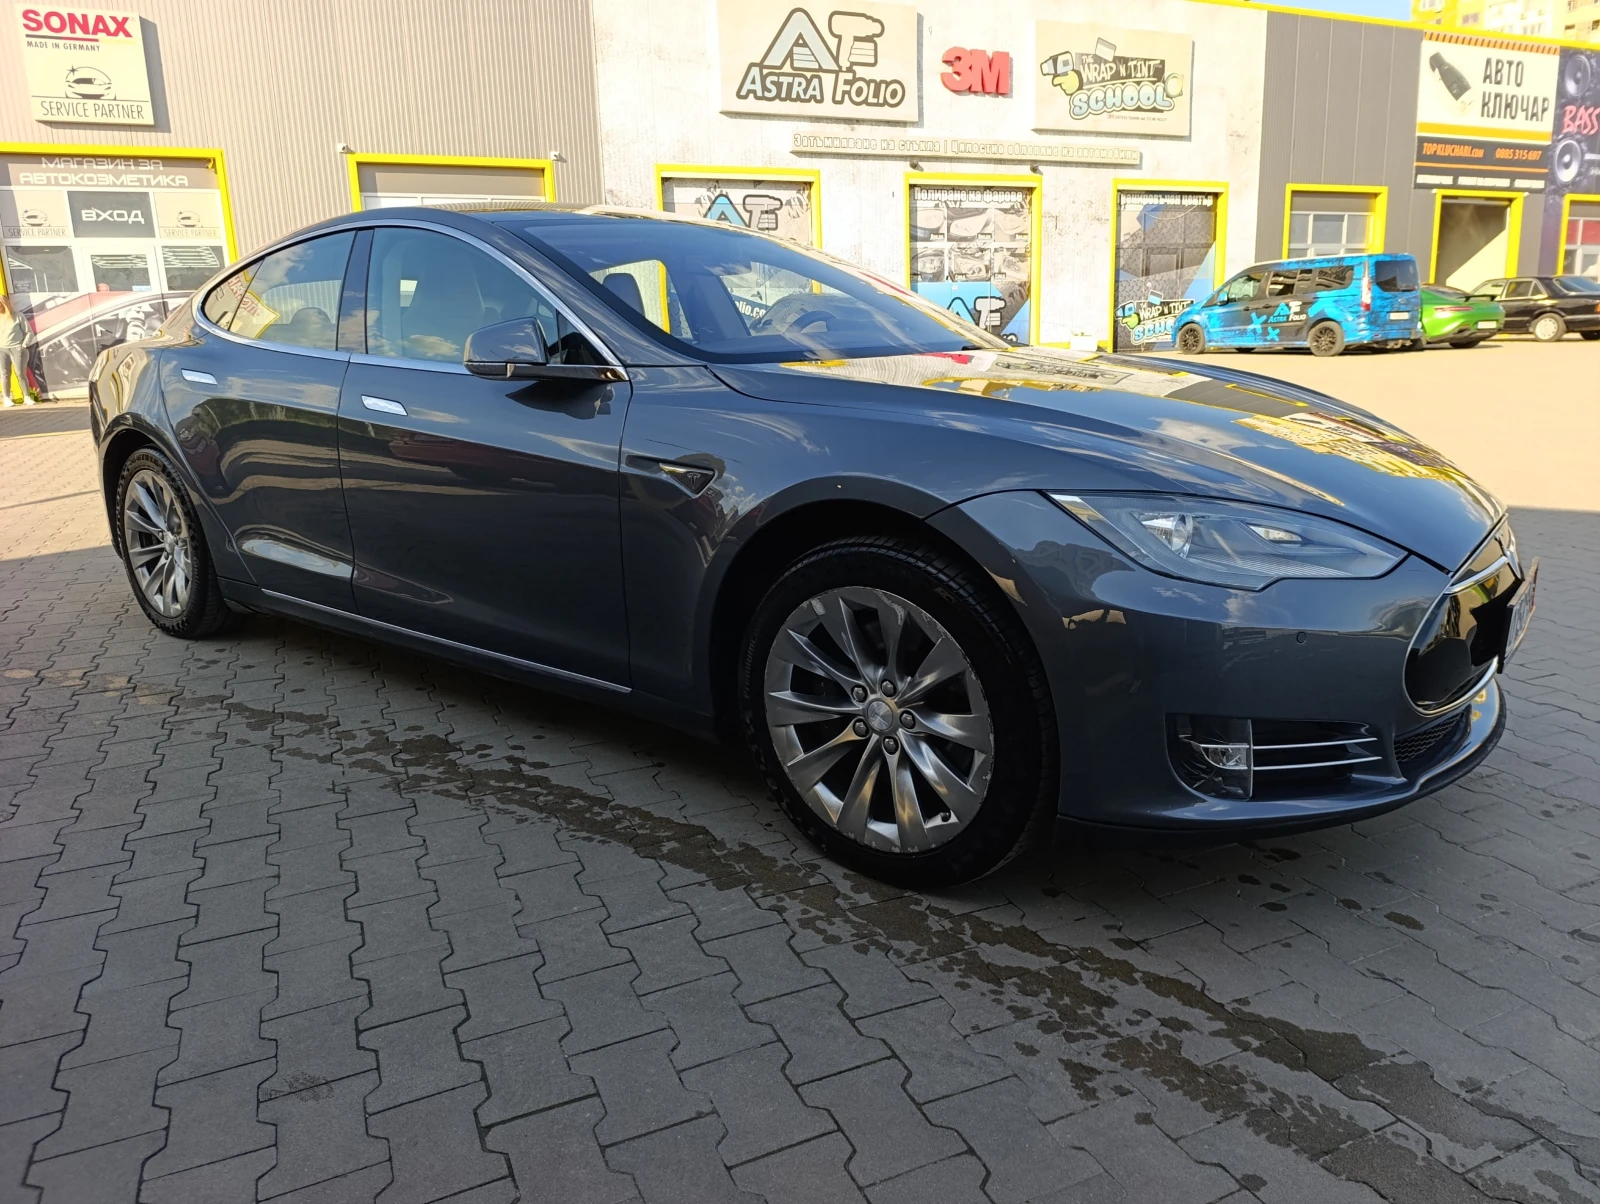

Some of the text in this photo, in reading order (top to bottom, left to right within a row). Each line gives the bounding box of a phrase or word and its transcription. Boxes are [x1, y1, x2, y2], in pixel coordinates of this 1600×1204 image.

[22, 9, 133, 38] SONAX
[26, 40, 100, 52] MADE IN GERMANY
[1082, 55, 1094, 63] THE
[940, 47, 1009, 95] 3M
[1080, 62, 1116, 83] WRAP
[1128, 60, 1160, 79] TINT
[1483, 57, 1524, 88] АВТО
[738, 64, 905, 107] ASTRA FOLIO
[1071, 83, 1173, 118] SCHOOL
[1481, 91, 1550, 122] КЛЮЧАР
[40, 101, 144, 120] SERVICE PARTNER
[794, 133, 877, 150] Затъмняване
[881, 138, 896, 151] на
[899, 139, 941, 153] стъкла
[951, 140, 1003, 155] Цялостно
[1007, 143, 1059, 157] облепяне
[1061, 146, 1074, 158] на
[1077, 146, 1138, 160] автомобили
[41, 157, 164, 170] МАГАЗИН ЗА
[19, 172, 189, 187] АВТОКОЗМЕТИКА
[968, 189, 982, 202] на
[81, 209, 145, 224] ВХОД
[8, 228, 66, 237] SERVICE PARTNER
[164, 228, 217, 237] SERVICE PARTNER
[1139, 306, 1162, 320] WRAP
[1132, 318, 1175, 342] SCHO
